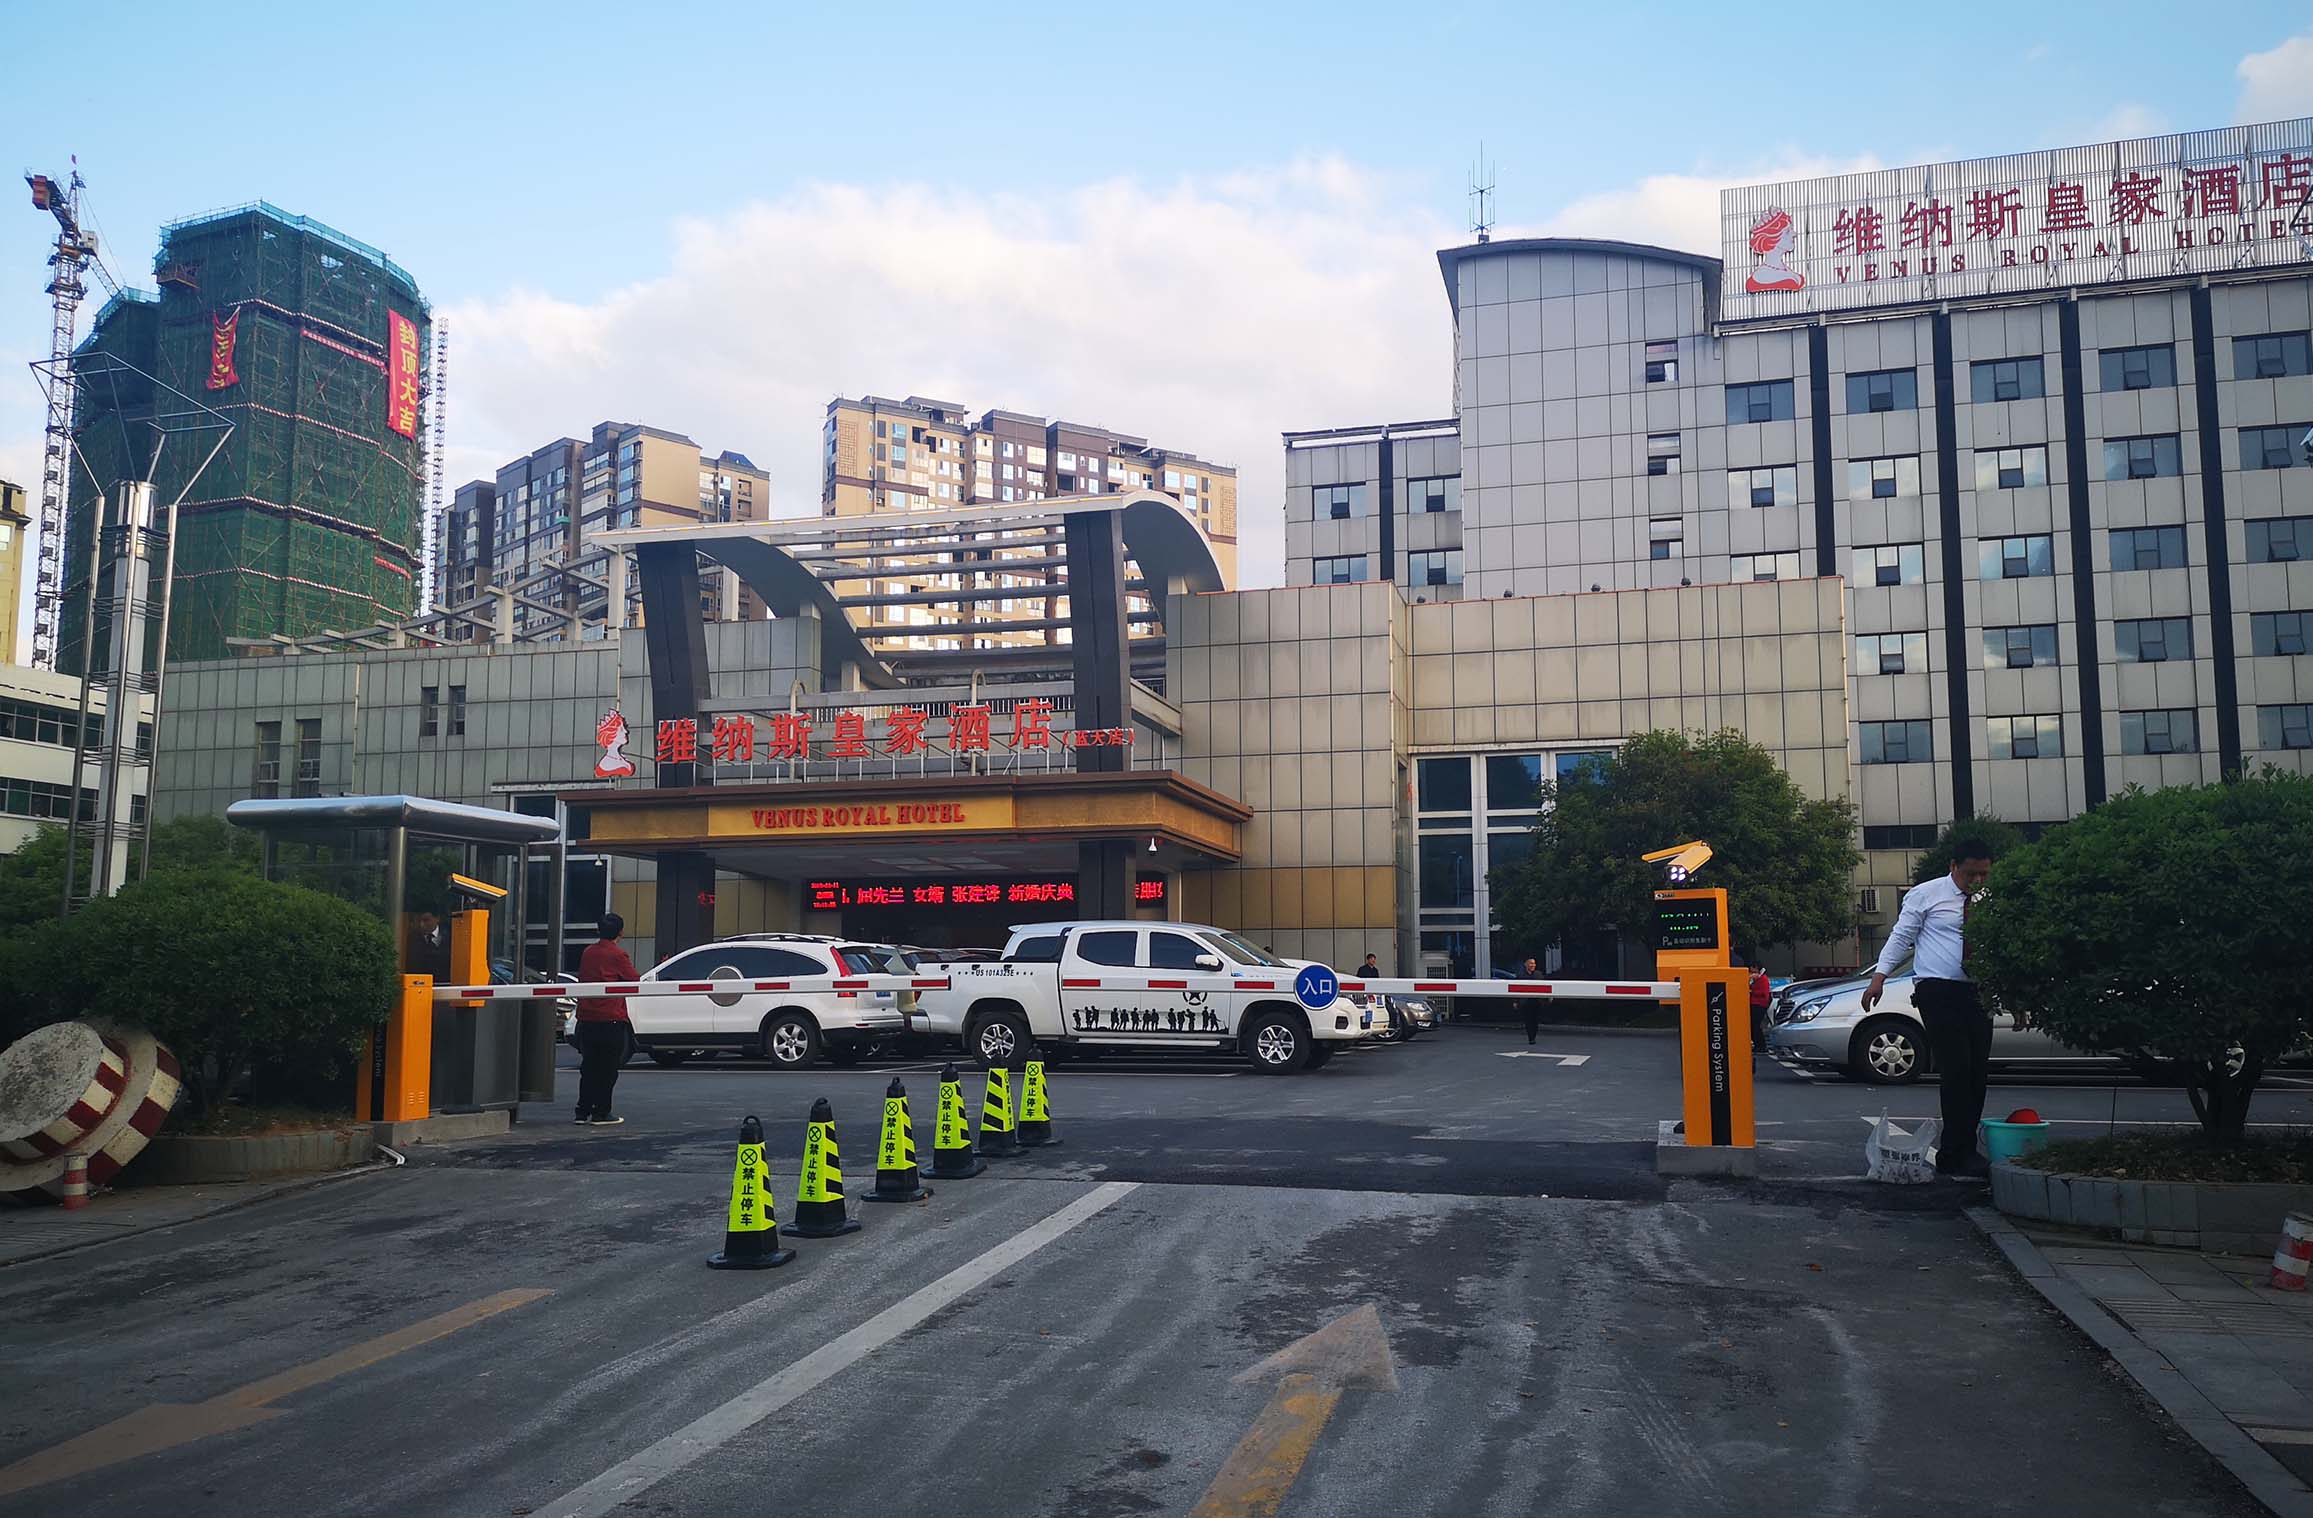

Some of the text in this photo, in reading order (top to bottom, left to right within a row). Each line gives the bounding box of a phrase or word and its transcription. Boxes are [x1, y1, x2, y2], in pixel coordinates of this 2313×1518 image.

[1833, 152, 2313, 256] 维纳斯皇家酒店
[1835, 254, 1966, 284] VENUS
[2001, 237, 2140, 267] ROYAL
[655, 697, 1053, 764] 维纳斯皇家酒店
[751, 802, 966, 829] VENUS ROYAL HOTEL
[1302, 977, 1333, 996] 入口
[1711, 1008, 1724, 1092] Parking System
[1026, 1077, 1037, 1118] 禁止停车
[885, 1117, 897, 1166] 禁止停车
[941, 1100, 952, 1145] 禁止停车
[805, 1143, 820, 1197] 禁止停车
[740, 1167, 756, 1227] 禁止停车
